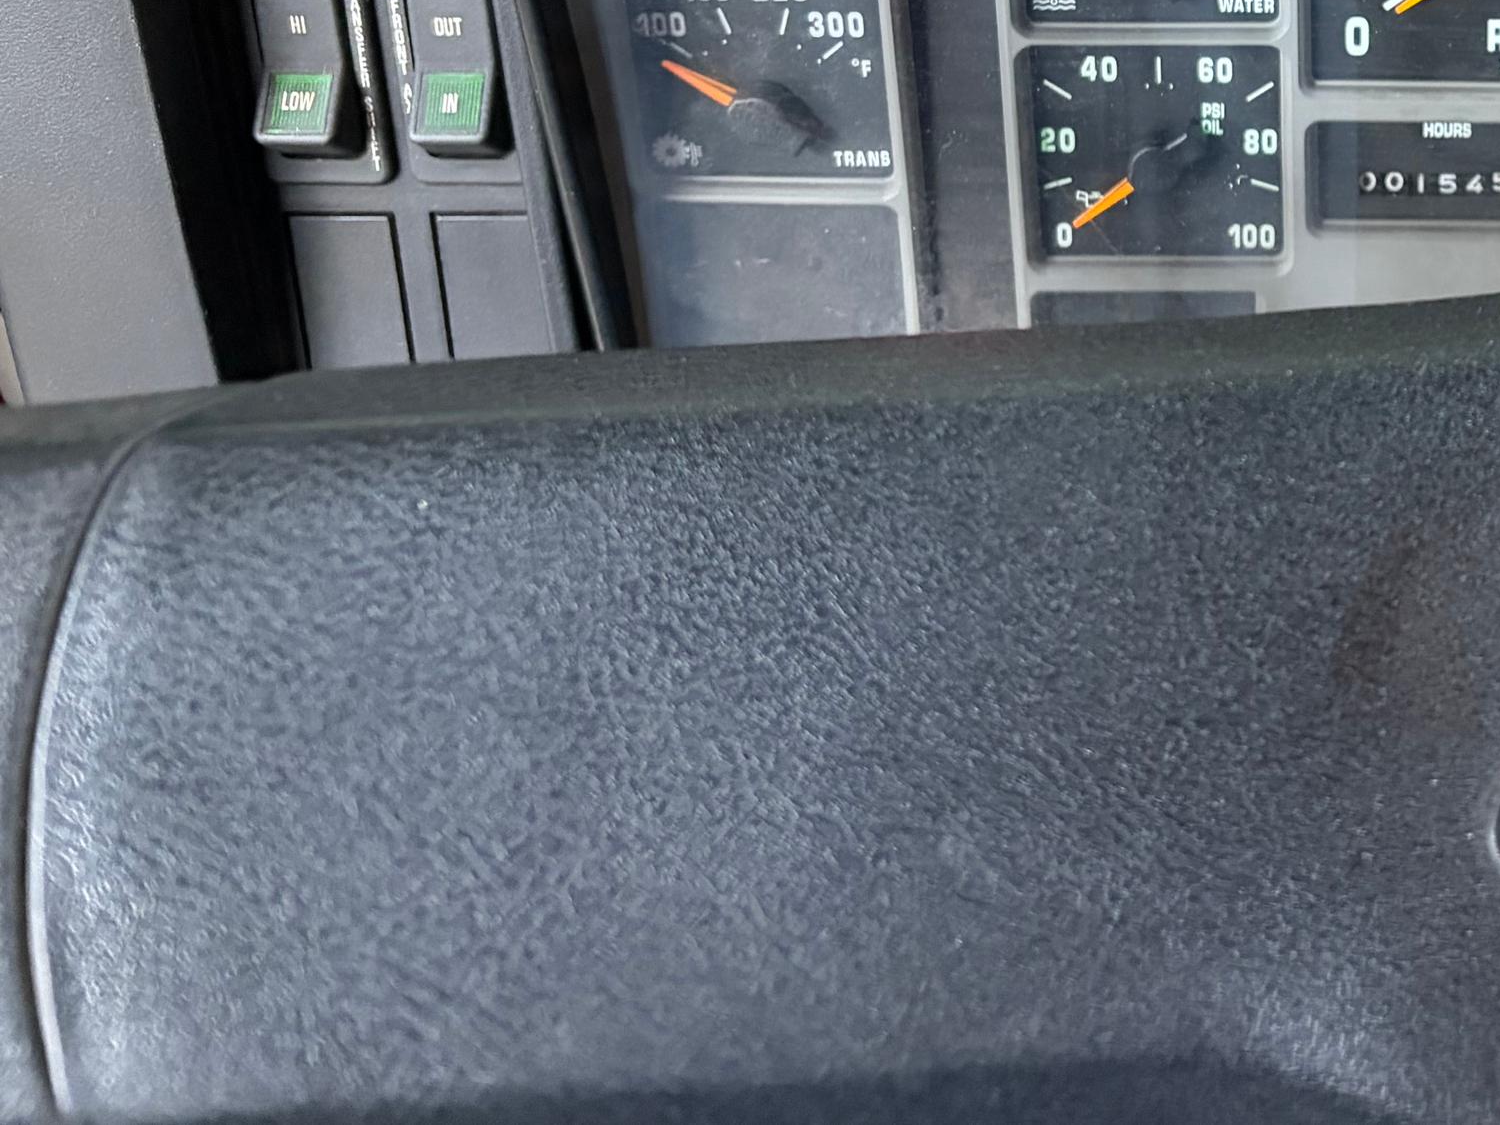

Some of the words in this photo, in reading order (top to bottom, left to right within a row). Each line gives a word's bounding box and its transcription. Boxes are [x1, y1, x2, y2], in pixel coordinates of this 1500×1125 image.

[289, 15, 307, 35] HI
[433, 17, 462, 37] OUT
[636, 12, 687, 37] 100
[807, 11, 864, 38] 300
[1344, 16, 1370, 57] 0
[1081, 56, 1117, 82] 40
[1197, 57, 1233, 83] 60
[281, 91, 315, 111] LOW
[442, 92, 459, 114] IN
[1202, 103, 1225, 119] PSI
[1041, 127, 1075, 153] 20
[1201, 120, 1224, 135] OIL
[1422, 123, 1472, 138] HOURS
[1243, 129, 1277, 155] 80
[833, 150, 890, 167] TRANS
[1056, 222, 1073, 248] 0
[1228, 224, 1275, 249] 100
